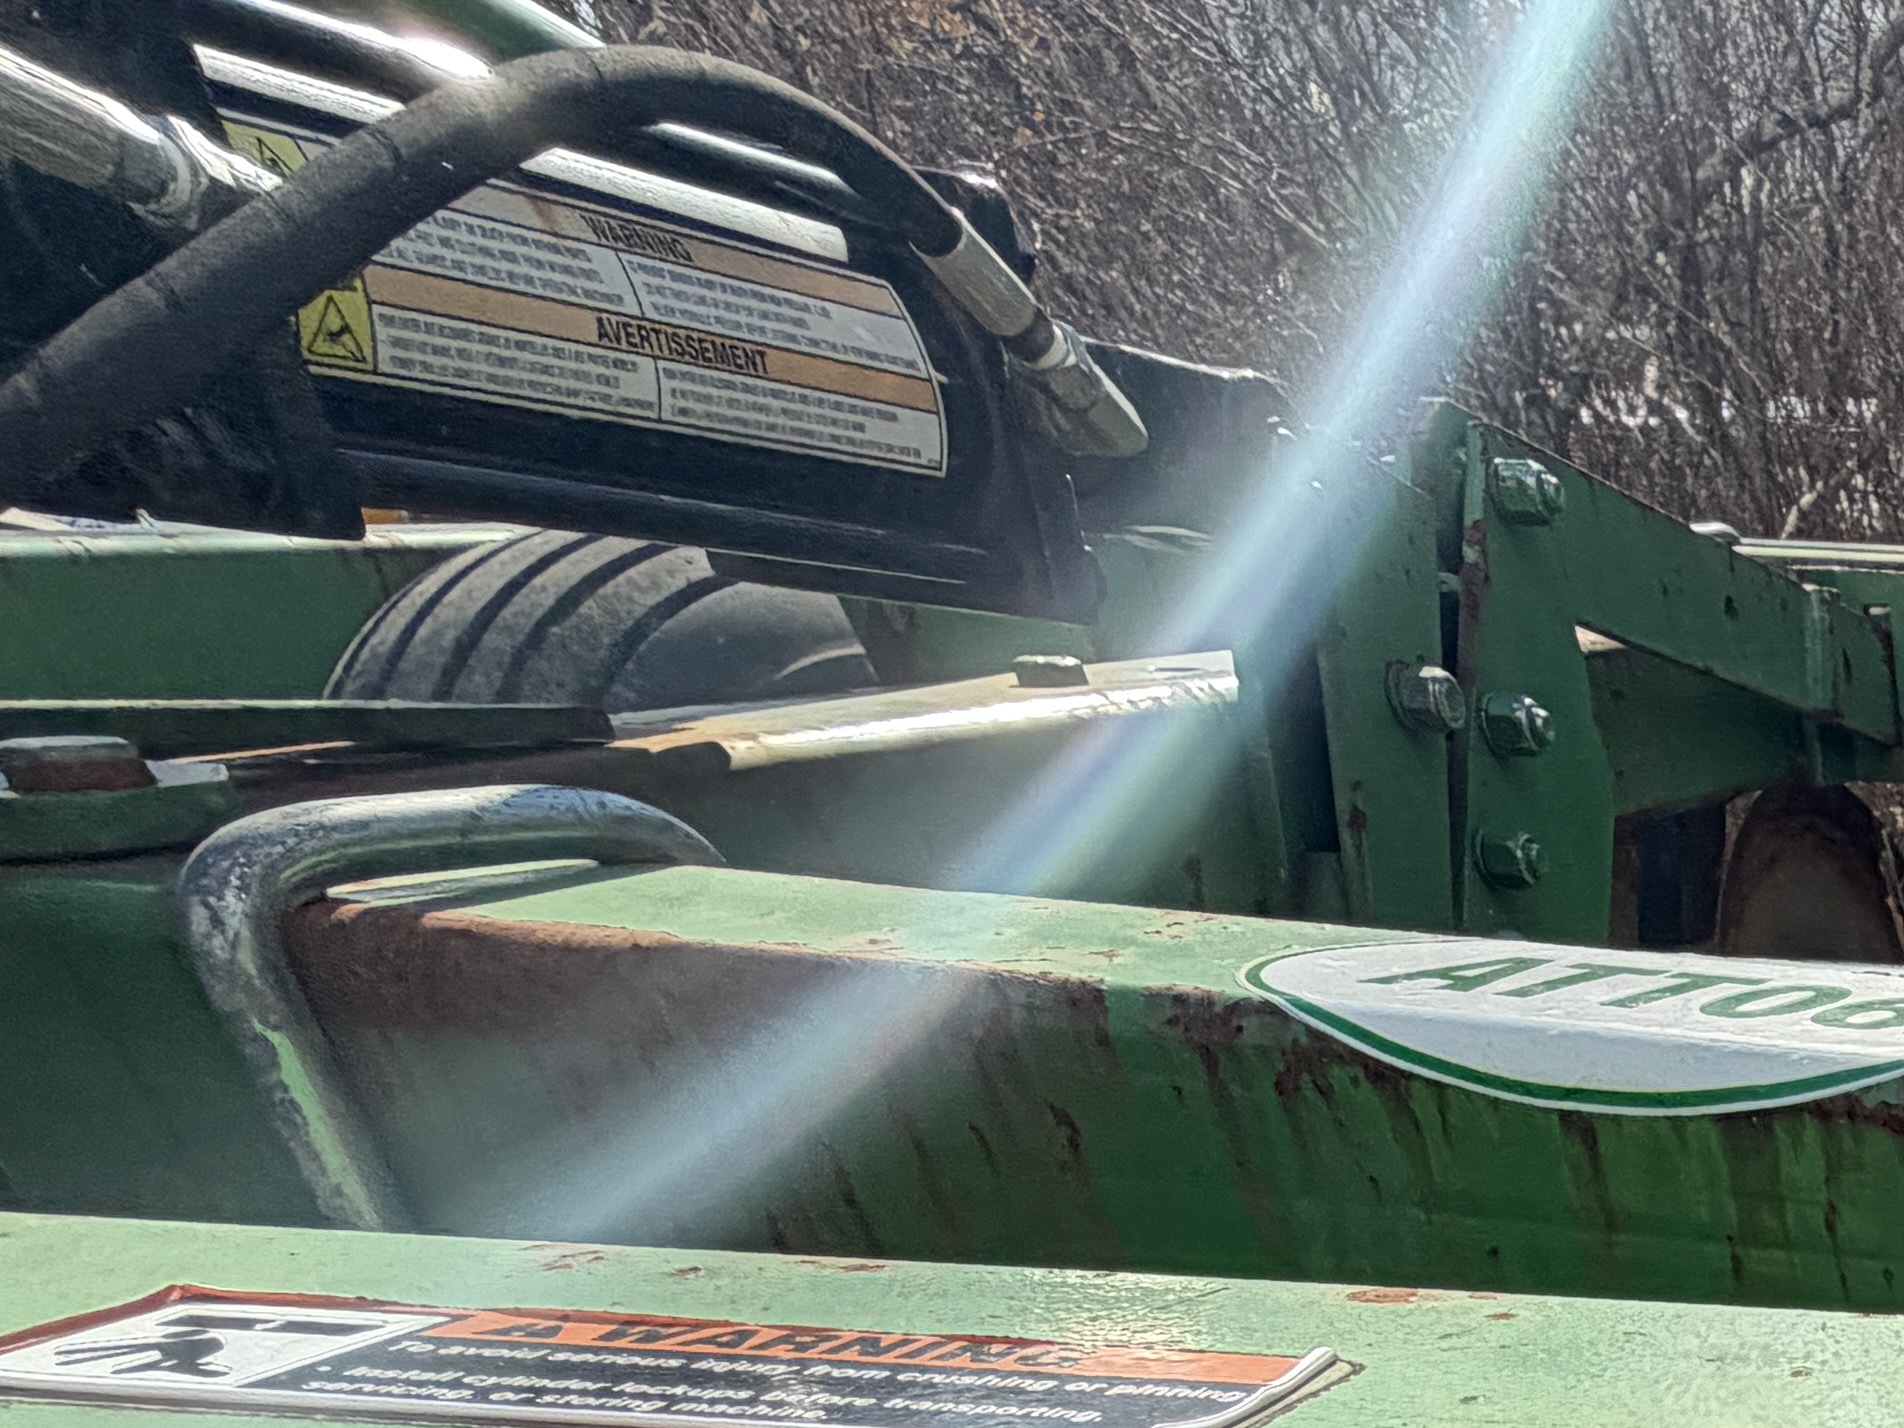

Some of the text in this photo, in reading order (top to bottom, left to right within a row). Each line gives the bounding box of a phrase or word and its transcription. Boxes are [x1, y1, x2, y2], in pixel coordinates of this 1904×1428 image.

[580, 214, 695, 264] WARNING
[595, 316, 769, 374] AVERTISSEMENT
[593, 1322, 1082, 1368] WARNING
[342, 1365, 465, 1383] Install
[462, 1371, 612, 1394] cylinder
[612, 1381, 755, 1401] lockups
[760, 1389, 878, 1407] before
[388, 1340, 1246, 1403] To avoid serious injury from crushing or pinning
[488, 1391, 534, 1402] or
[536, 1392, 669, 1412] storing
